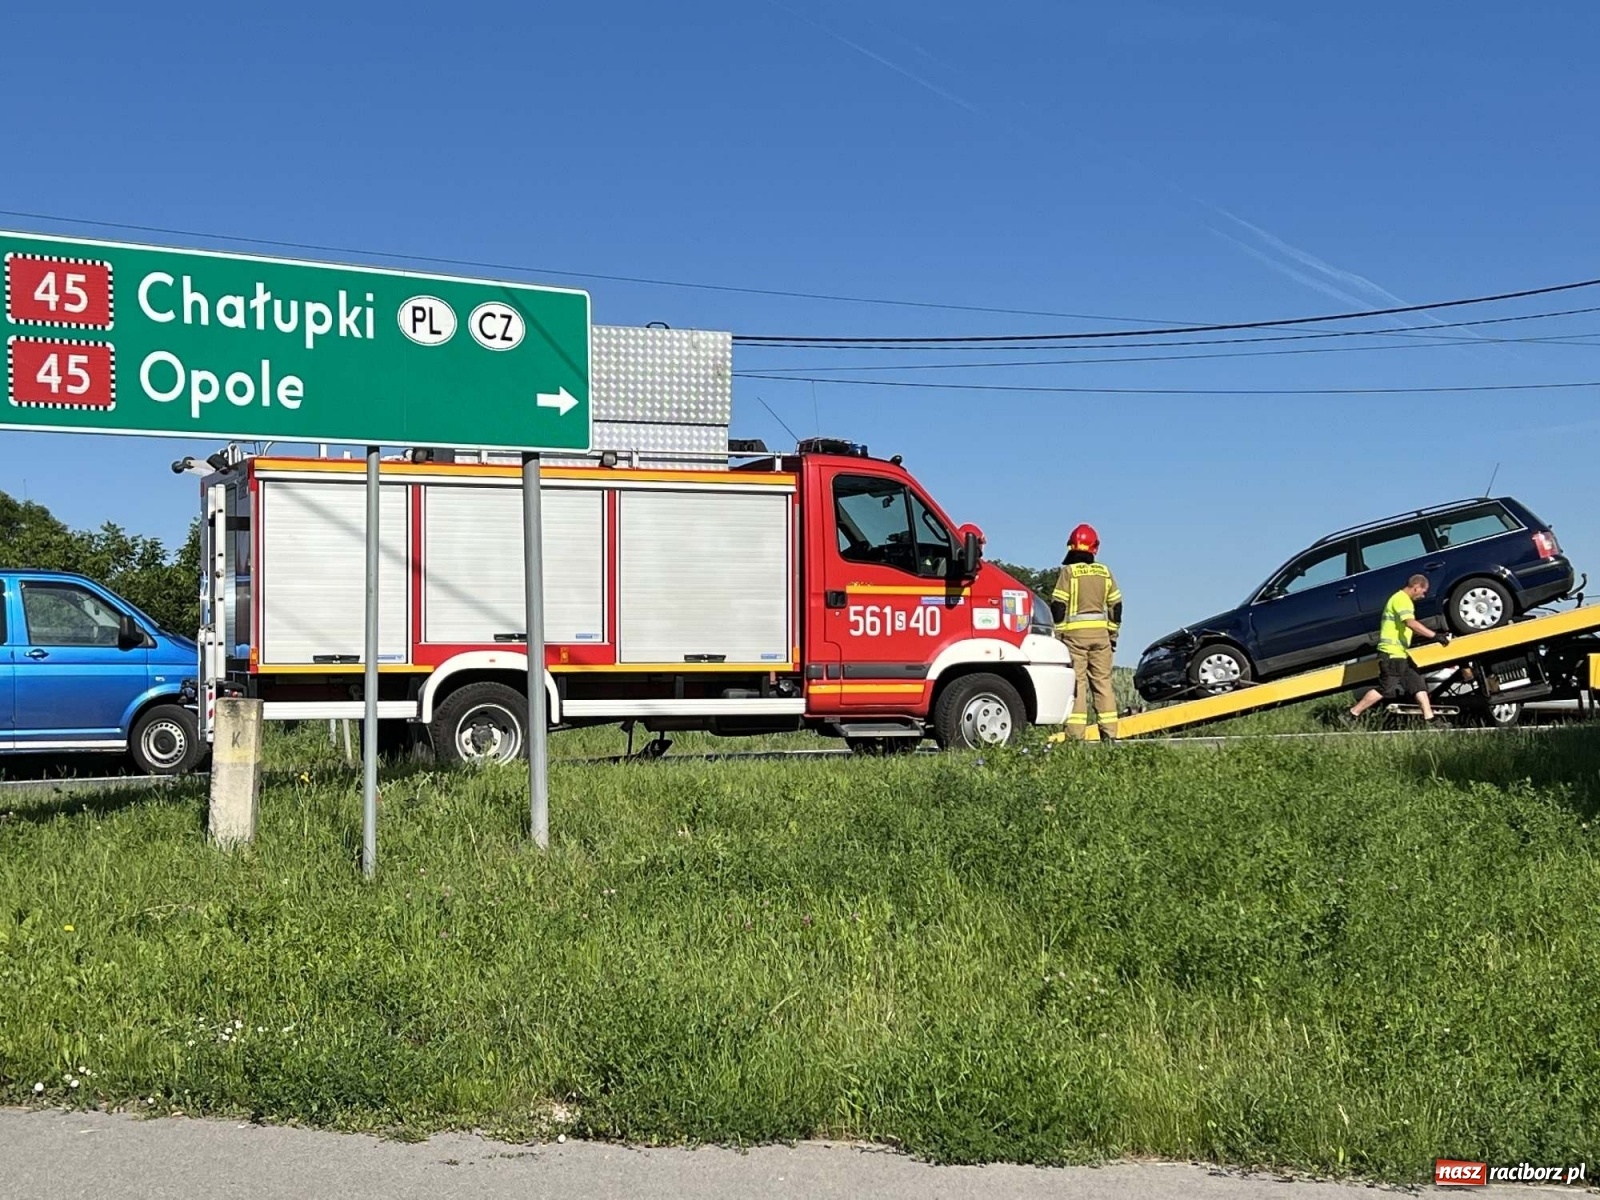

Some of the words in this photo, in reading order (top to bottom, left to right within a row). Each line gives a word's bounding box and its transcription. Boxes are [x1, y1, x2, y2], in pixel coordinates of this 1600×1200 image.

[33, 271, 88, 313] 45
[137, 271, 376, 349] Chałupki
[411, 305, 443, 336] PL
[478, 311, 513, 342] CZ
[36, 353, 91, 394] 45
[139, 350, 304, 418] Opole
[848, 605, 892, 637] 561
[909, 605, 941, 637] 40
[231, 731, 241, 749] K
